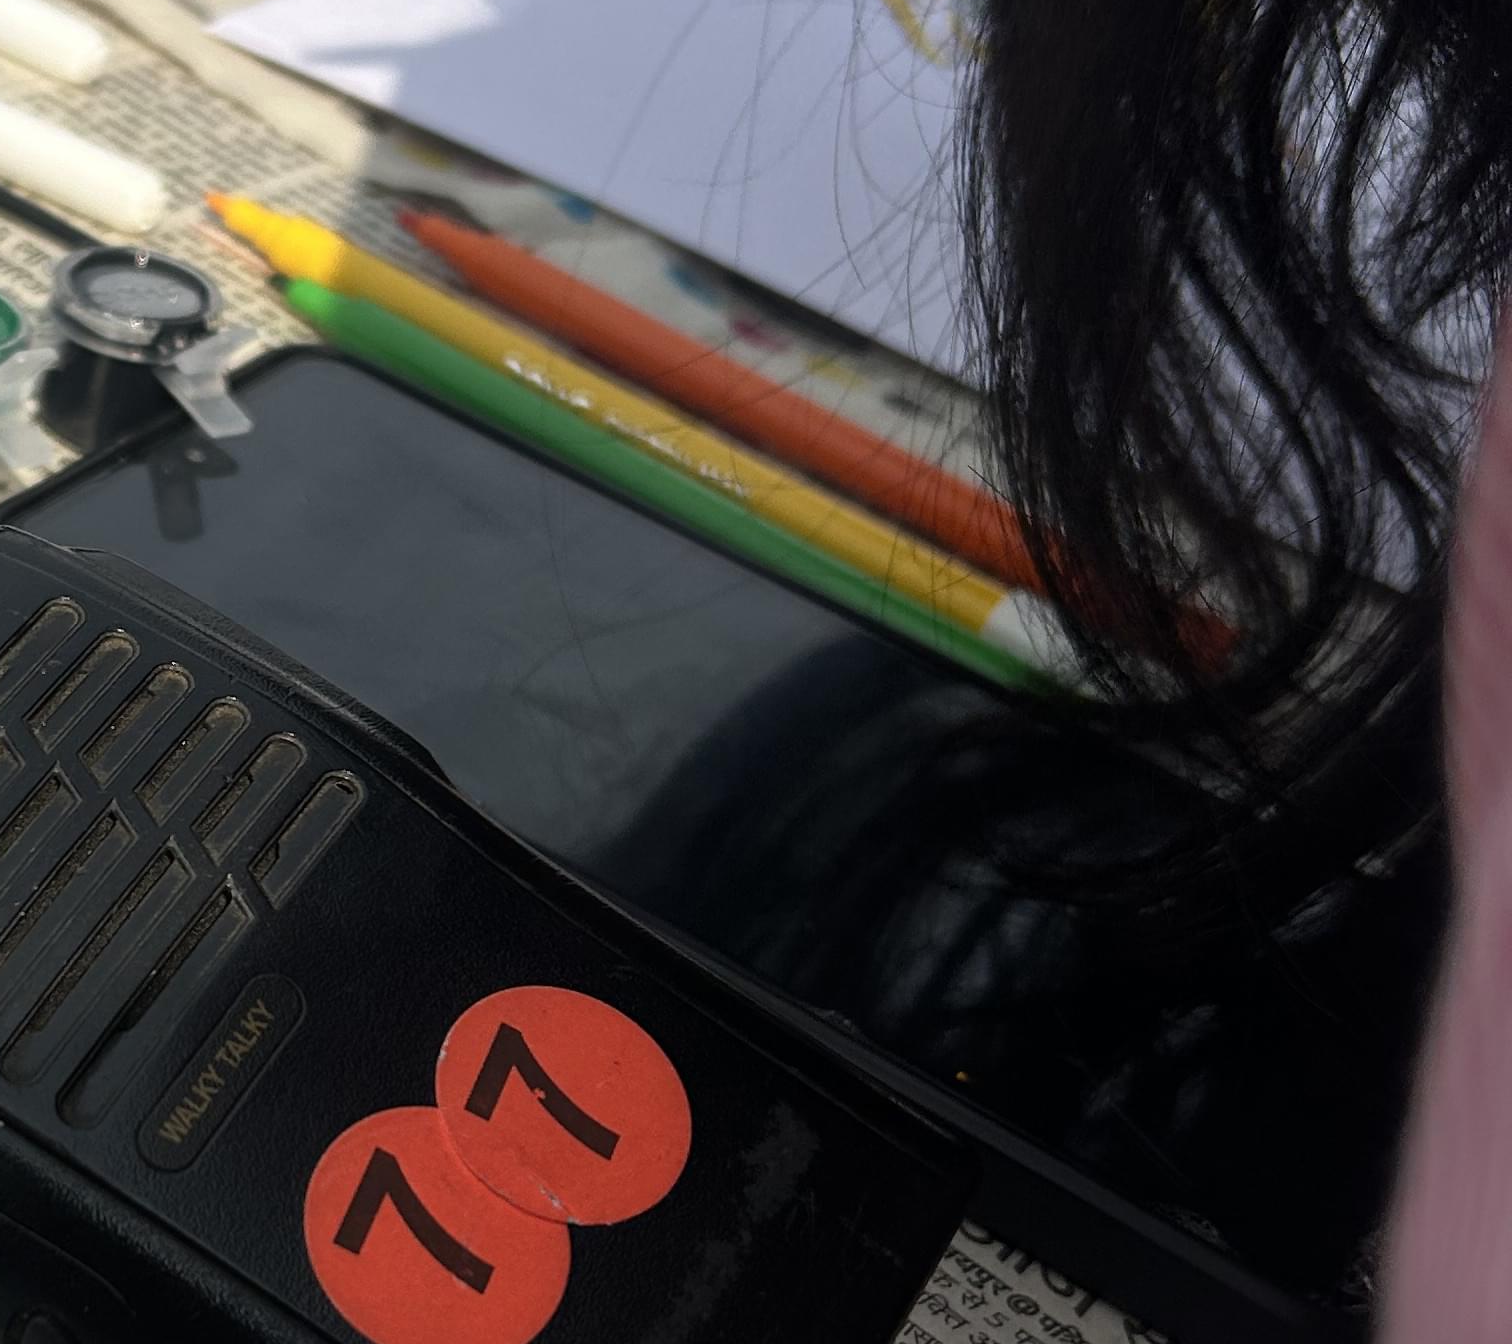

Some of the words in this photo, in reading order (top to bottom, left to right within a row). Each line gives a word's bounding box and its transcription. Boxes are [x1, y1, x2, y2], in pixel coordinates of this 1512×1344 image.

[158, 1063, 226, 1145] WALKY
[215, 998, 276, 1069] TALKY
[464, 1022, 622, 1162] 7
[333, 1146, 496, 1296] 7
